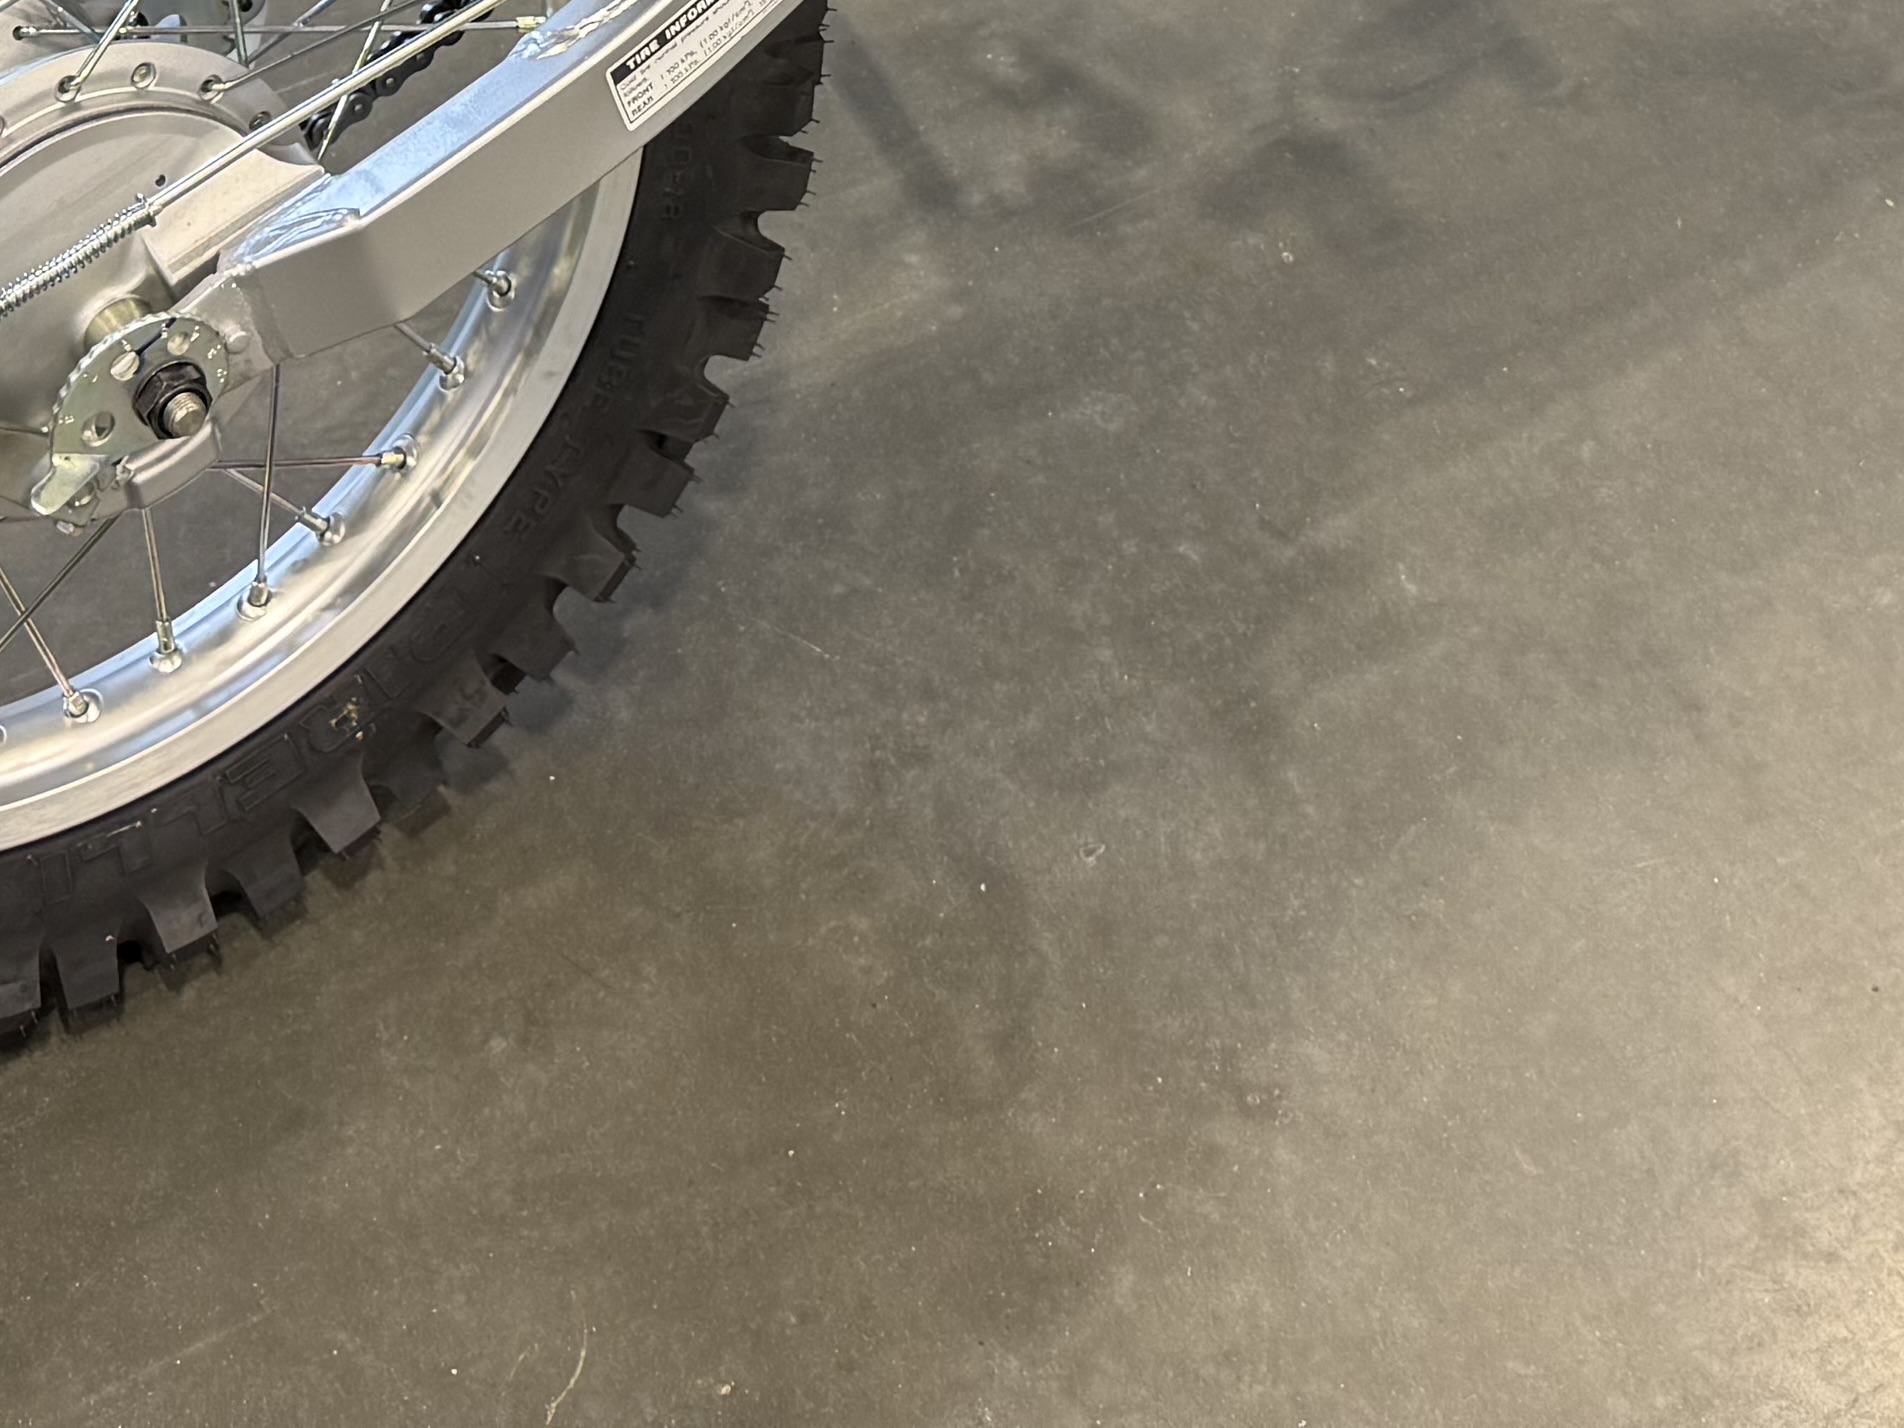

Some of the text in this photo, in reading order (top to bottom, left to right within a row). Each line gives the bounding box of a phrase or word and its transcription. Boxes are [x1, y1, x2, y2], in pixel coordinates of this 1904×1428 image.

[625, 36, 660, 72] TIRE
[627, 81, 654, 108] FRONT
[631, 93, 653, 117] REAR
[39, 585, 473, 907] PIRELLI
